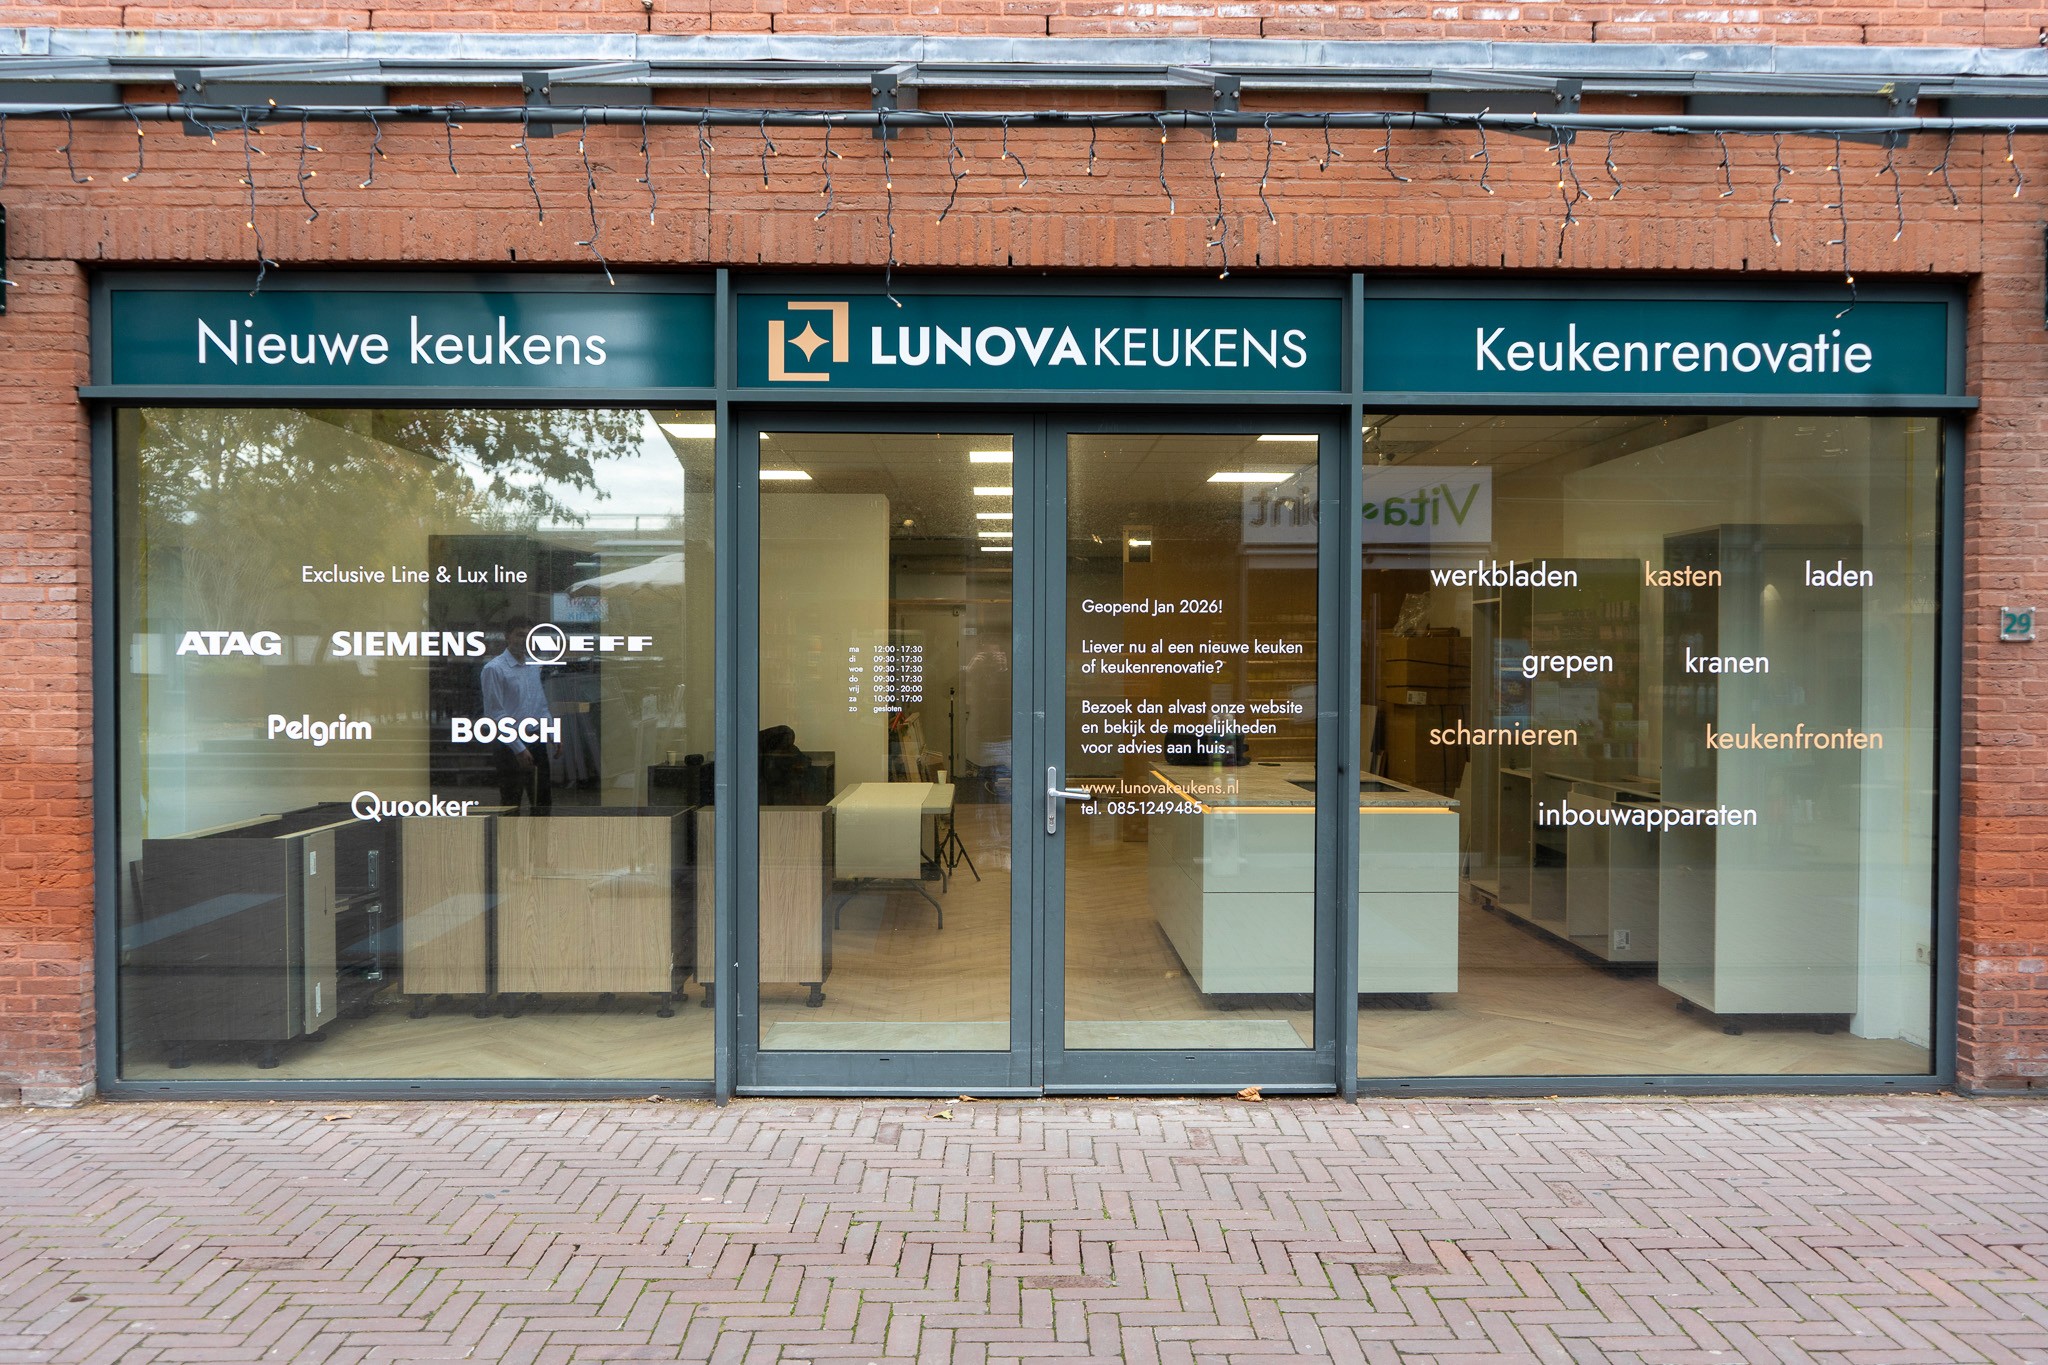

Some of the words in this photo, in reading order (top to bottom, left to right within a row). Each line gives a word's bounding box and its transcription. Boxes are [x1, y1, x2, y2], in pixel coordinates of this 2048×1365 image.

[198, 318, 389, 365] Nieuwe
[411, 315, 606, 365] keukens
[1094, 326, 1308, 370] KEUKENS
[1477, 323, 1872, 373] Keukenrenovatie
[303, 564, 385, 582] Exclusive
[393, 566, 429, 582] Line
[436, 566, 451, 583] &
[458, 566, 488, 583] Lux
[495, 564, 527, 583] line
[1431, 560, 1578, 586] werkbladen
[1646, 561, 1721, 586] kasten
[1806, 560, 1873, 586] laden
[1082, 598, 1148, 616] Geopend
[1152, 600, 1174, 616] Jan
[1180, 600, 1222, 613] 2026!
[2004, 613, 2031, 633] 29
[177, 631, 281, 655] ATAG
[331, 630, 486, 657] SIEMENS
[1083, 640, 1124, 653] Liever
[1129, 643, 1147, 654] nu
[1151, 639, 1162, 653] al
[1168, 644, 1193, 653] een
[1200, 640, 1249, 653] nieuwe
[1255, 639, 1302, 653] keuken
[1082, 658, 1096, 673] of
[1101, 659, 1224, 674] keukenrenovatie?
[1522, 655, 1613, 679] grepen
[1686, 647, 1768, 673] kranen
[849, 685, 859, 693] vrij
[874, 705, 902, 713] gesloten
[1082, 699, 1132, 713] Bezoek
[1137, 699, 1163, 713] dan
[1168, 699, 1206, 713] alvast
[1211, 703, 1246, 714] onze
[1250, 699, 1303, 713] website
[268, 714, 371, 746] Pelgrim
[451, 717, 561, 744] BOSCH
[1082, 724, 1098, 733] en
[1104, 719, 1145, 737] bekijk
[1150, 719, 1168, 733] de
[1173, 719, 1276, 737] mogelijkheden
[1430, 719, 1578, 746] scharnieren
[1707, 723, 1882, 749] keukenfronten
[1081, 744, 1113, 753] voor
[1117, 739, 1162, 753] advies
[1167, 744, 1191, 753] aan
[1197, 739, 1230, 754] huis.
[1082, 780, 1239, 794] www.lunovakeukens.nl
[351, 790, 474, 823] Quooker
[1081, 801, 1101, 815] tel.
[1108, 801, 1203, 815] 085-1249485
[1538, 800, 1757, 832] inbouwapparaten
